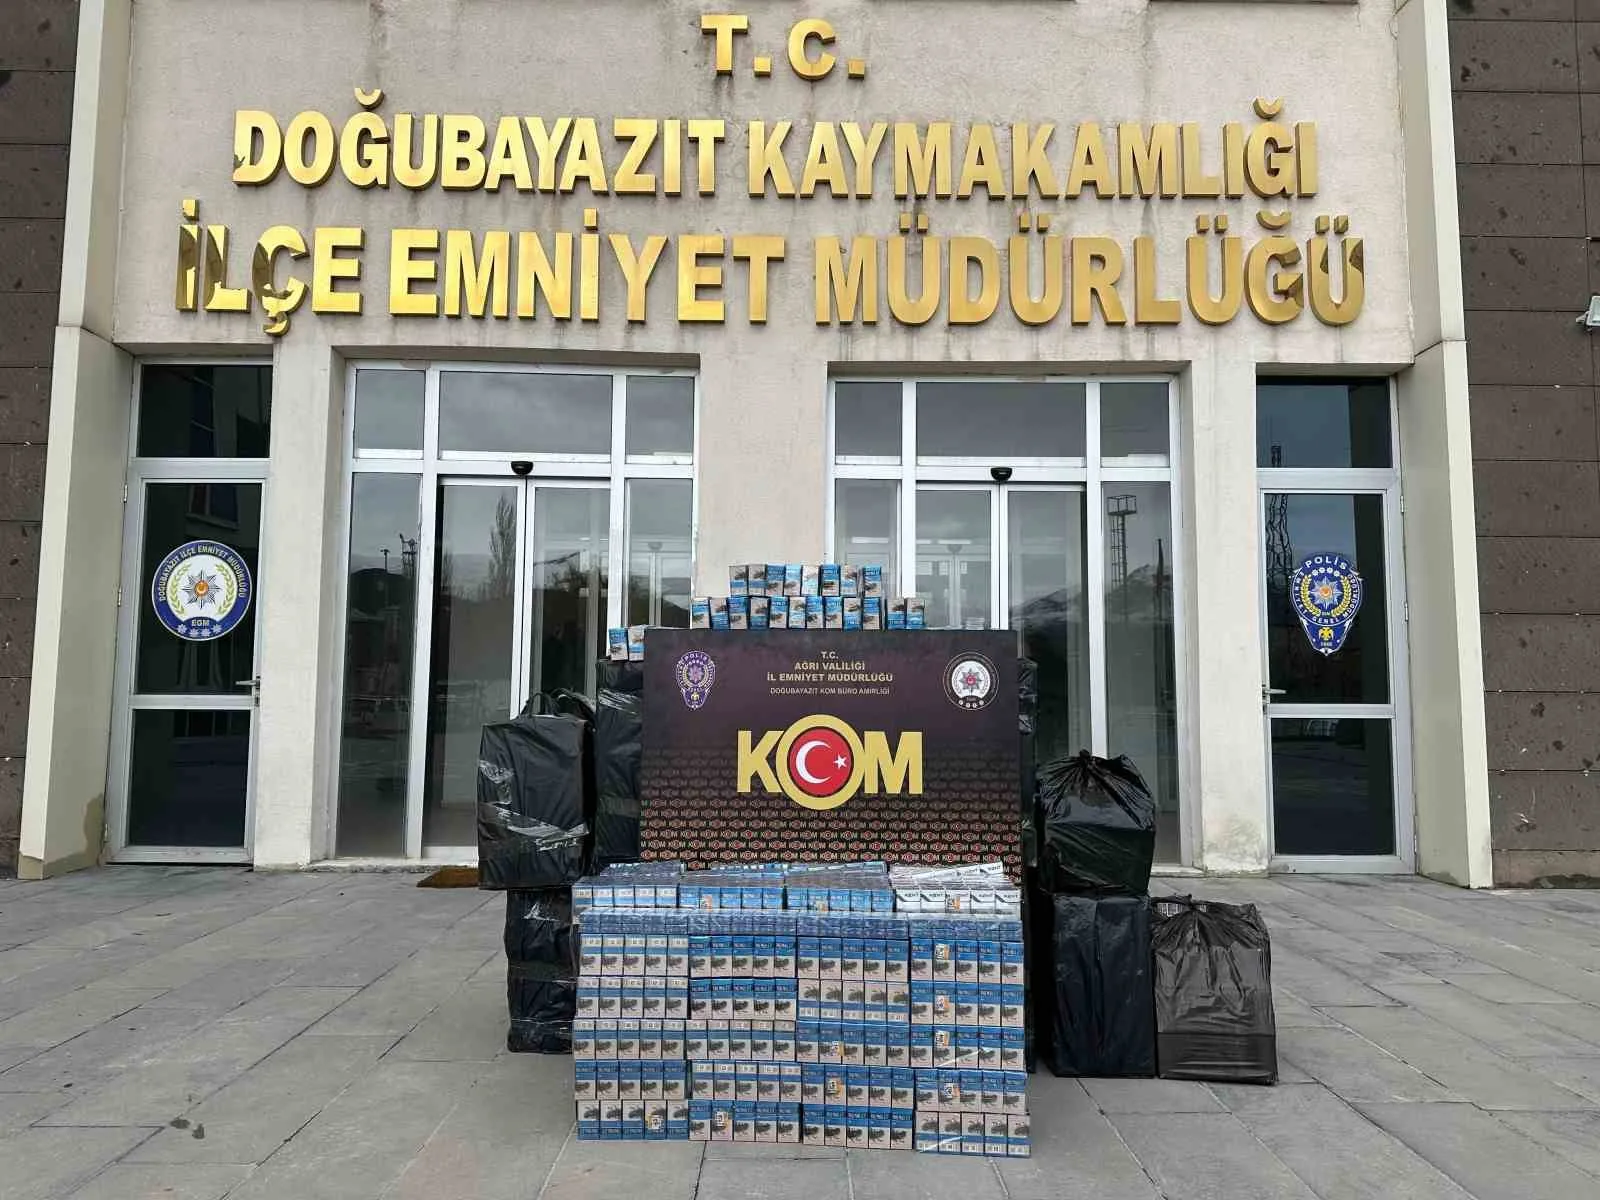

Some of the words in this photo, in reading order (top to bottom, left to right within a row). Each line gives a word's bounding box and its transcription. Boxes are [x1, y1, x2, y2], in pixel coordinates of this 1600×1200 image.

[702, 14, 866, 79] T.C.
[232, 88, 725, 197] DOĞUBAYAZIT
[748, 97, 1318, 201] KAYMAKAMLIĞI
[176, 199, 366, 336] İLÇE
[389, 207, 785, 324] EMNİYET
[814, 211, 1365, 327] MÜDÜRLÜĞÜ
[767, 671, 777, 681] İL
[779, 671, 825, 681] EMNİYET
[821, 651, 839, 660] T.C.
[820, 687, 836, 695] KOM
[737, 714, 923, 810] KOM
